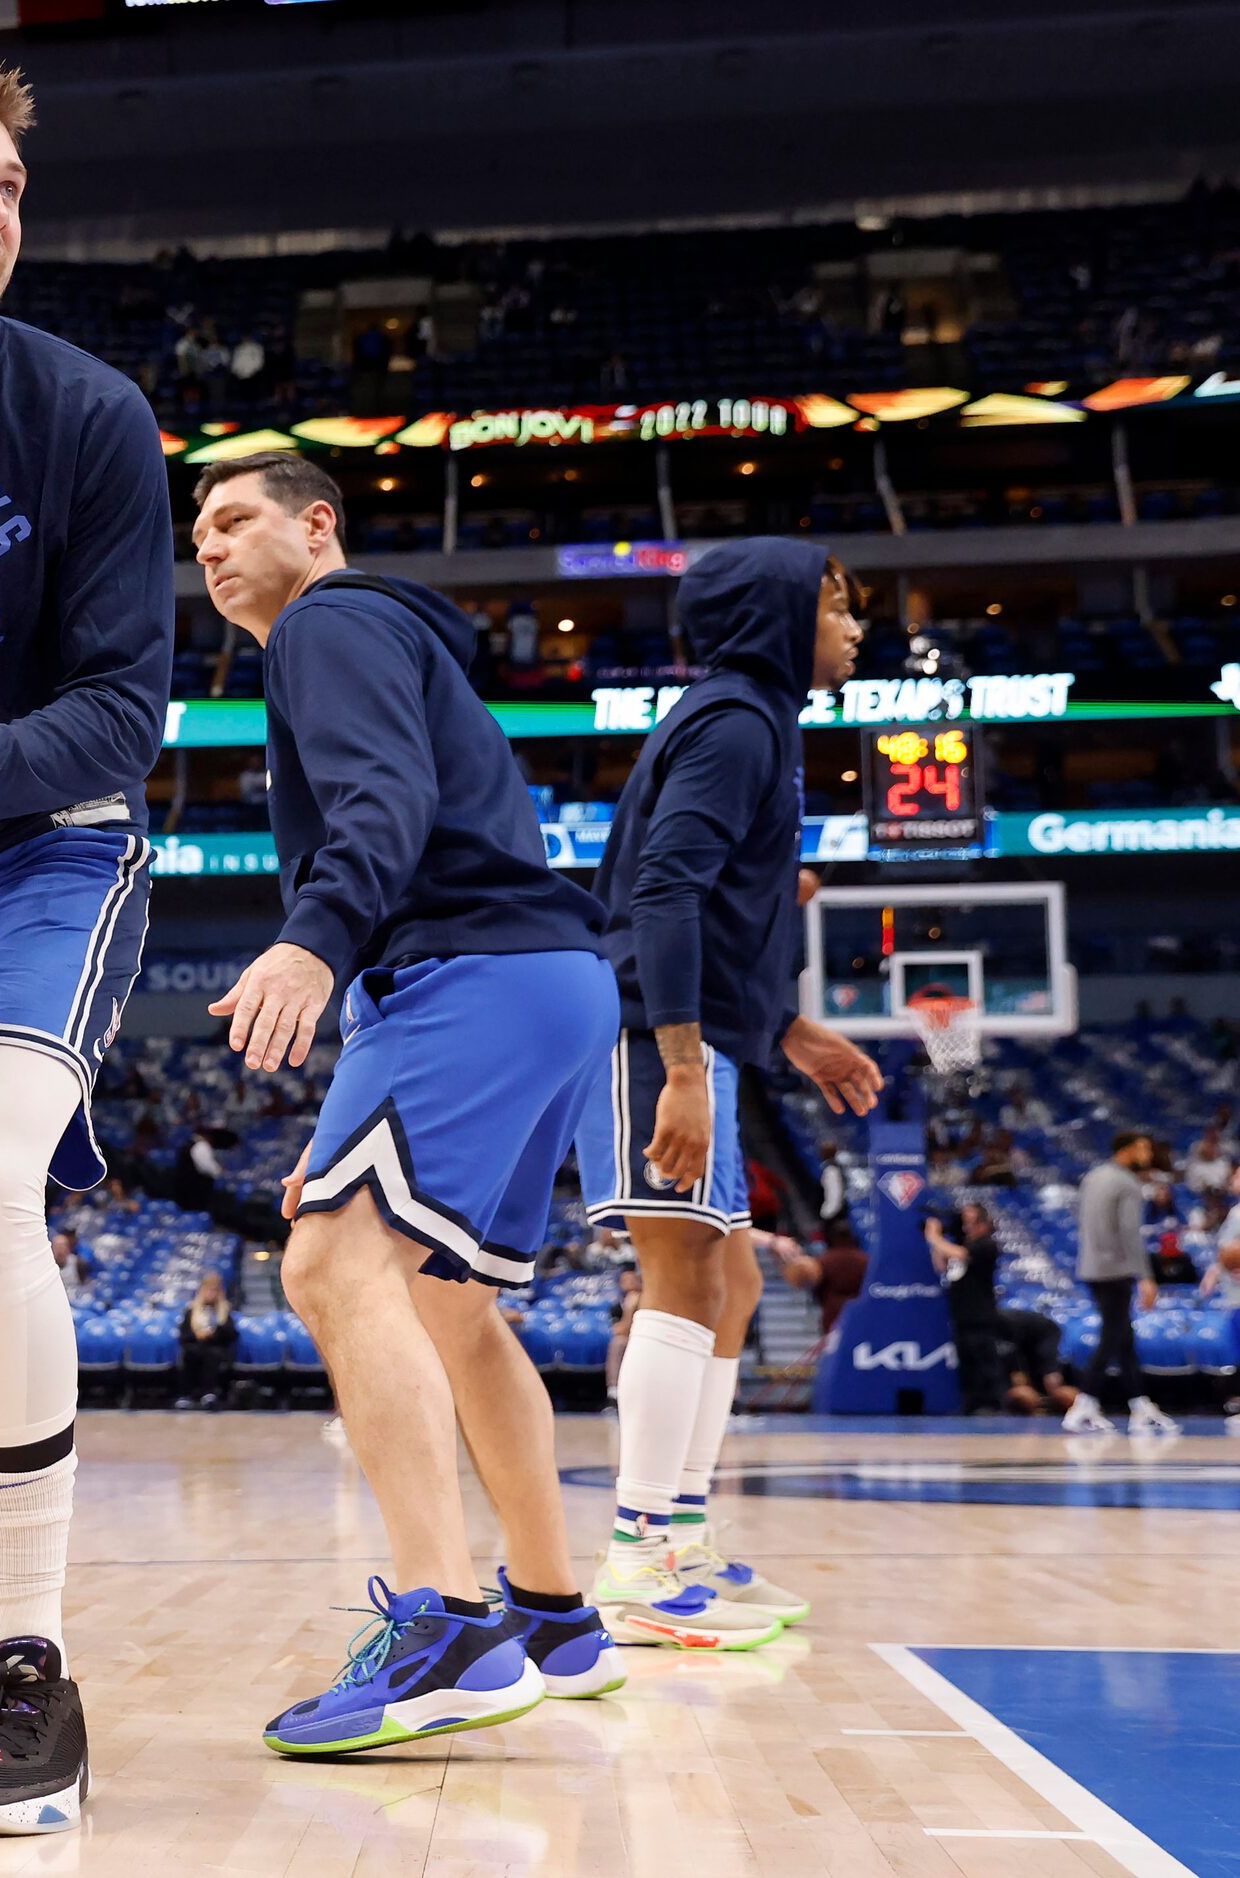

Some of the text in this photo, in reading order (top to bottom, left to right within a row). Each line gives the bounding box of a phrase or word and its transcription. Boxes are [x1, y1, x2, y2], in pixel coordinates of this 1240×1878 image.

[640, 399, 709, 441] 2022
[591, 686, 656, 731] THE
[966, 672, 1076, 719] TRUST
[887, 763, 961, 816] 24
[1028, 807, 1240, 853] Germania
